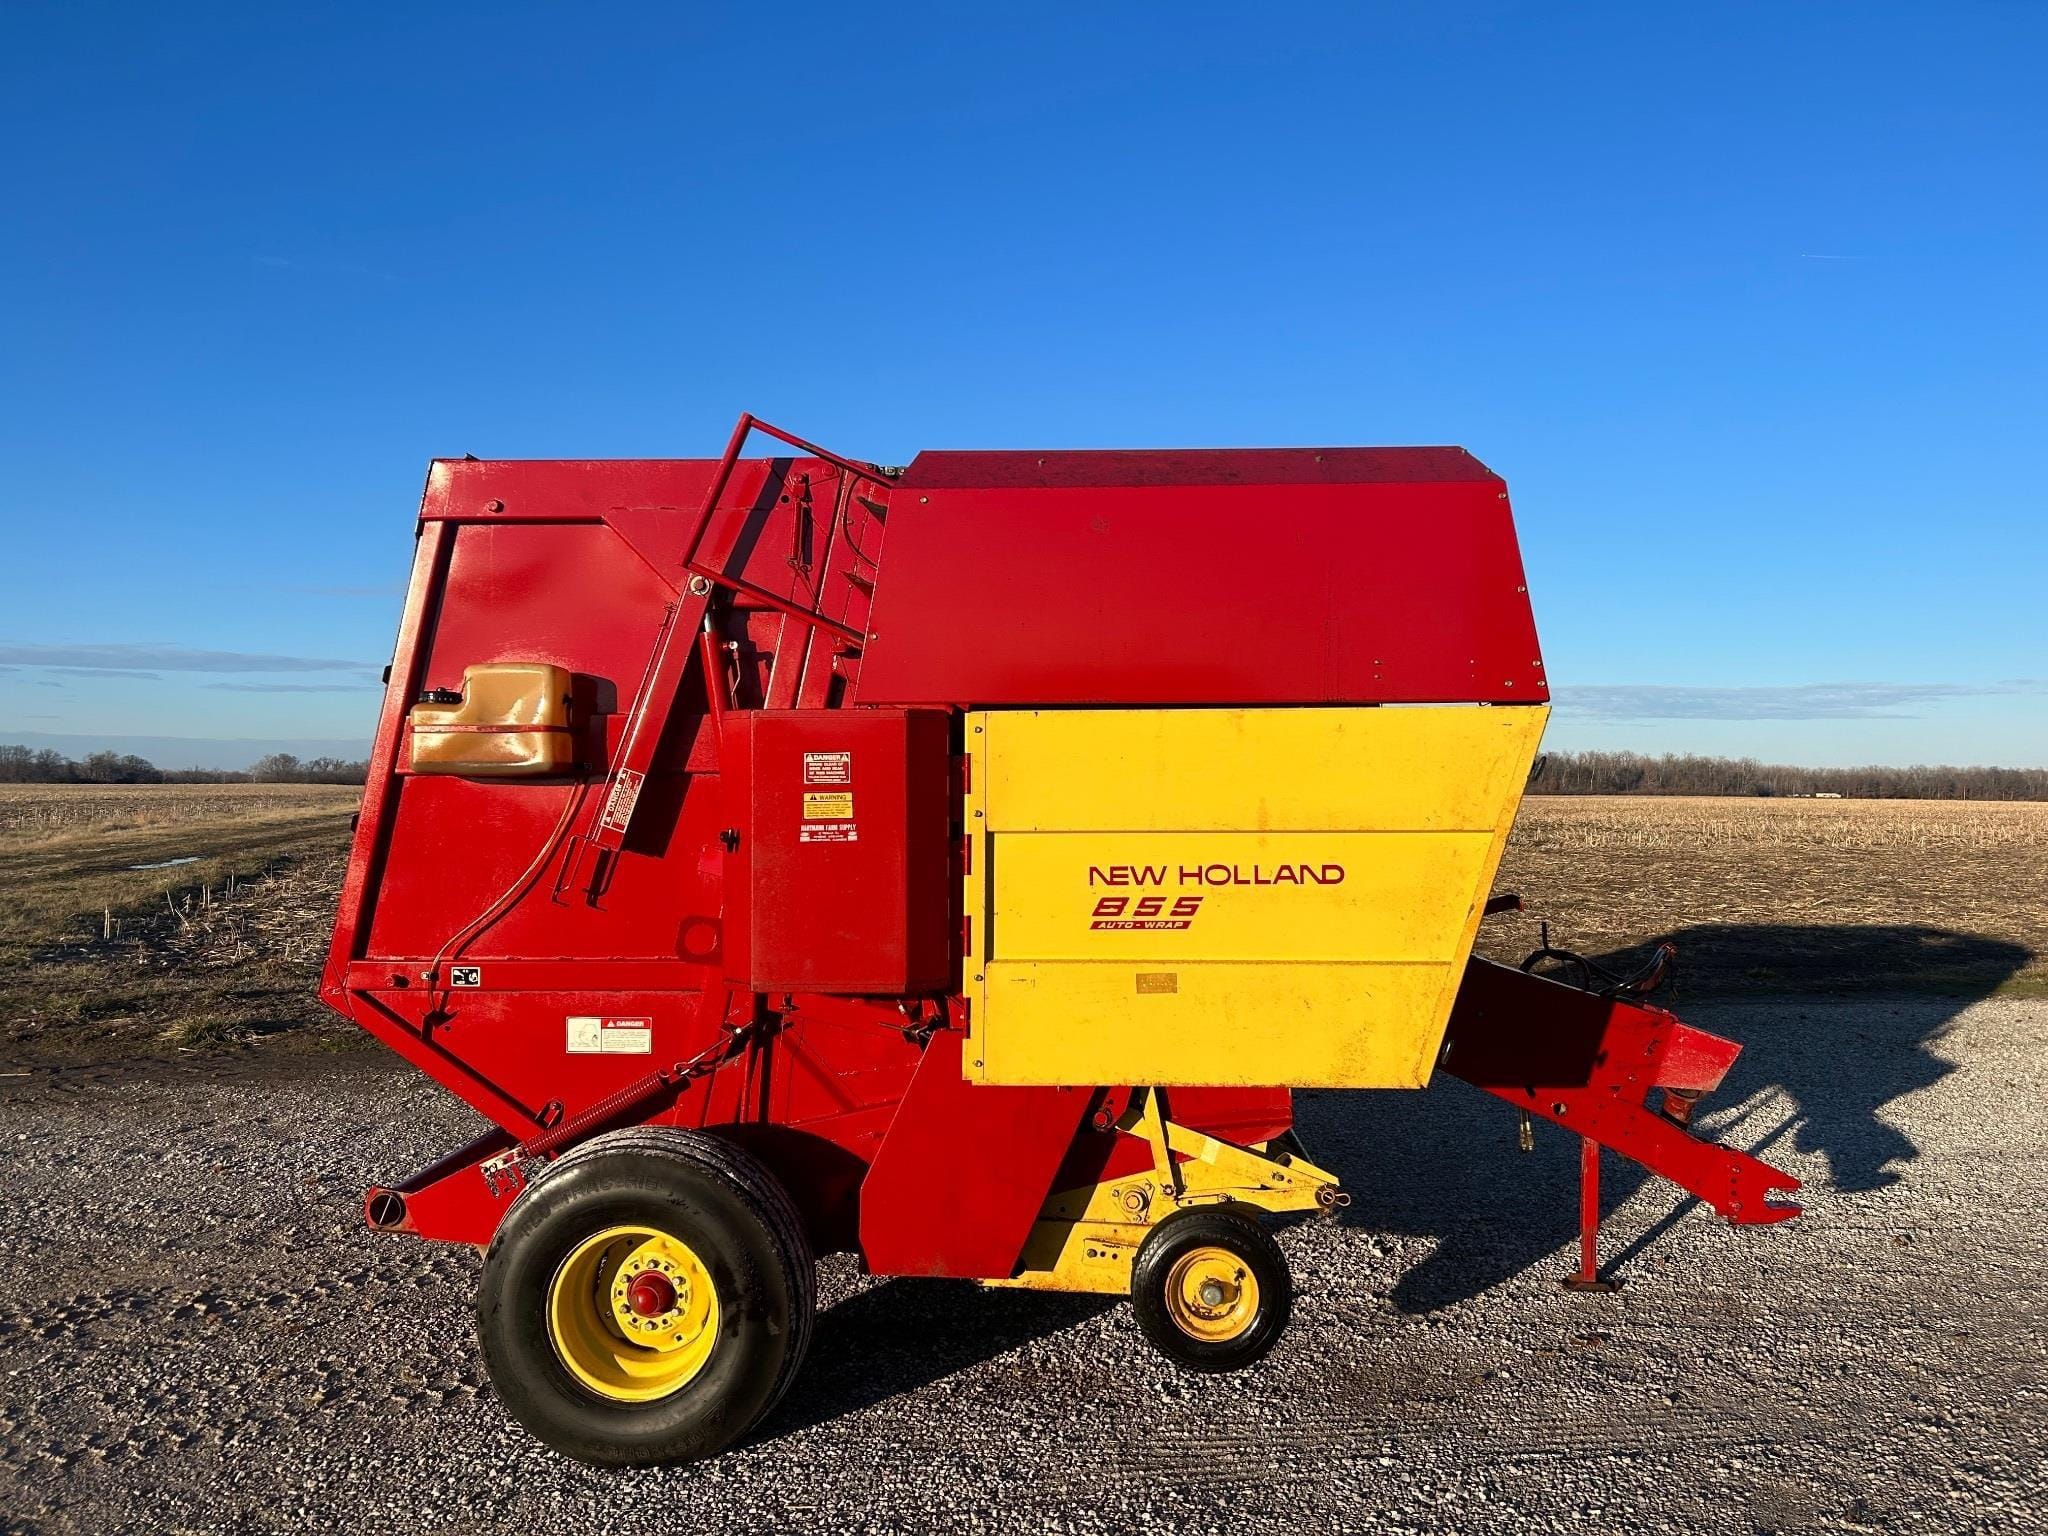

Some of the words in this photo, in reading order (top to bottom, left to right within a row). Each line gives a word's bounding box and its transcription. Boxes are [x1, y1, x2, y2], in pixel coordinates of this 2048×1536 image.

[608, 783, 623, 812] DANGER
[839, 823, 857, 831] SUPPLY
[1089, 865, 1167, 886] NEW
[1179, 864, 1345, 886] HOLLAND
[1091, 896, 1204, 917] 855
